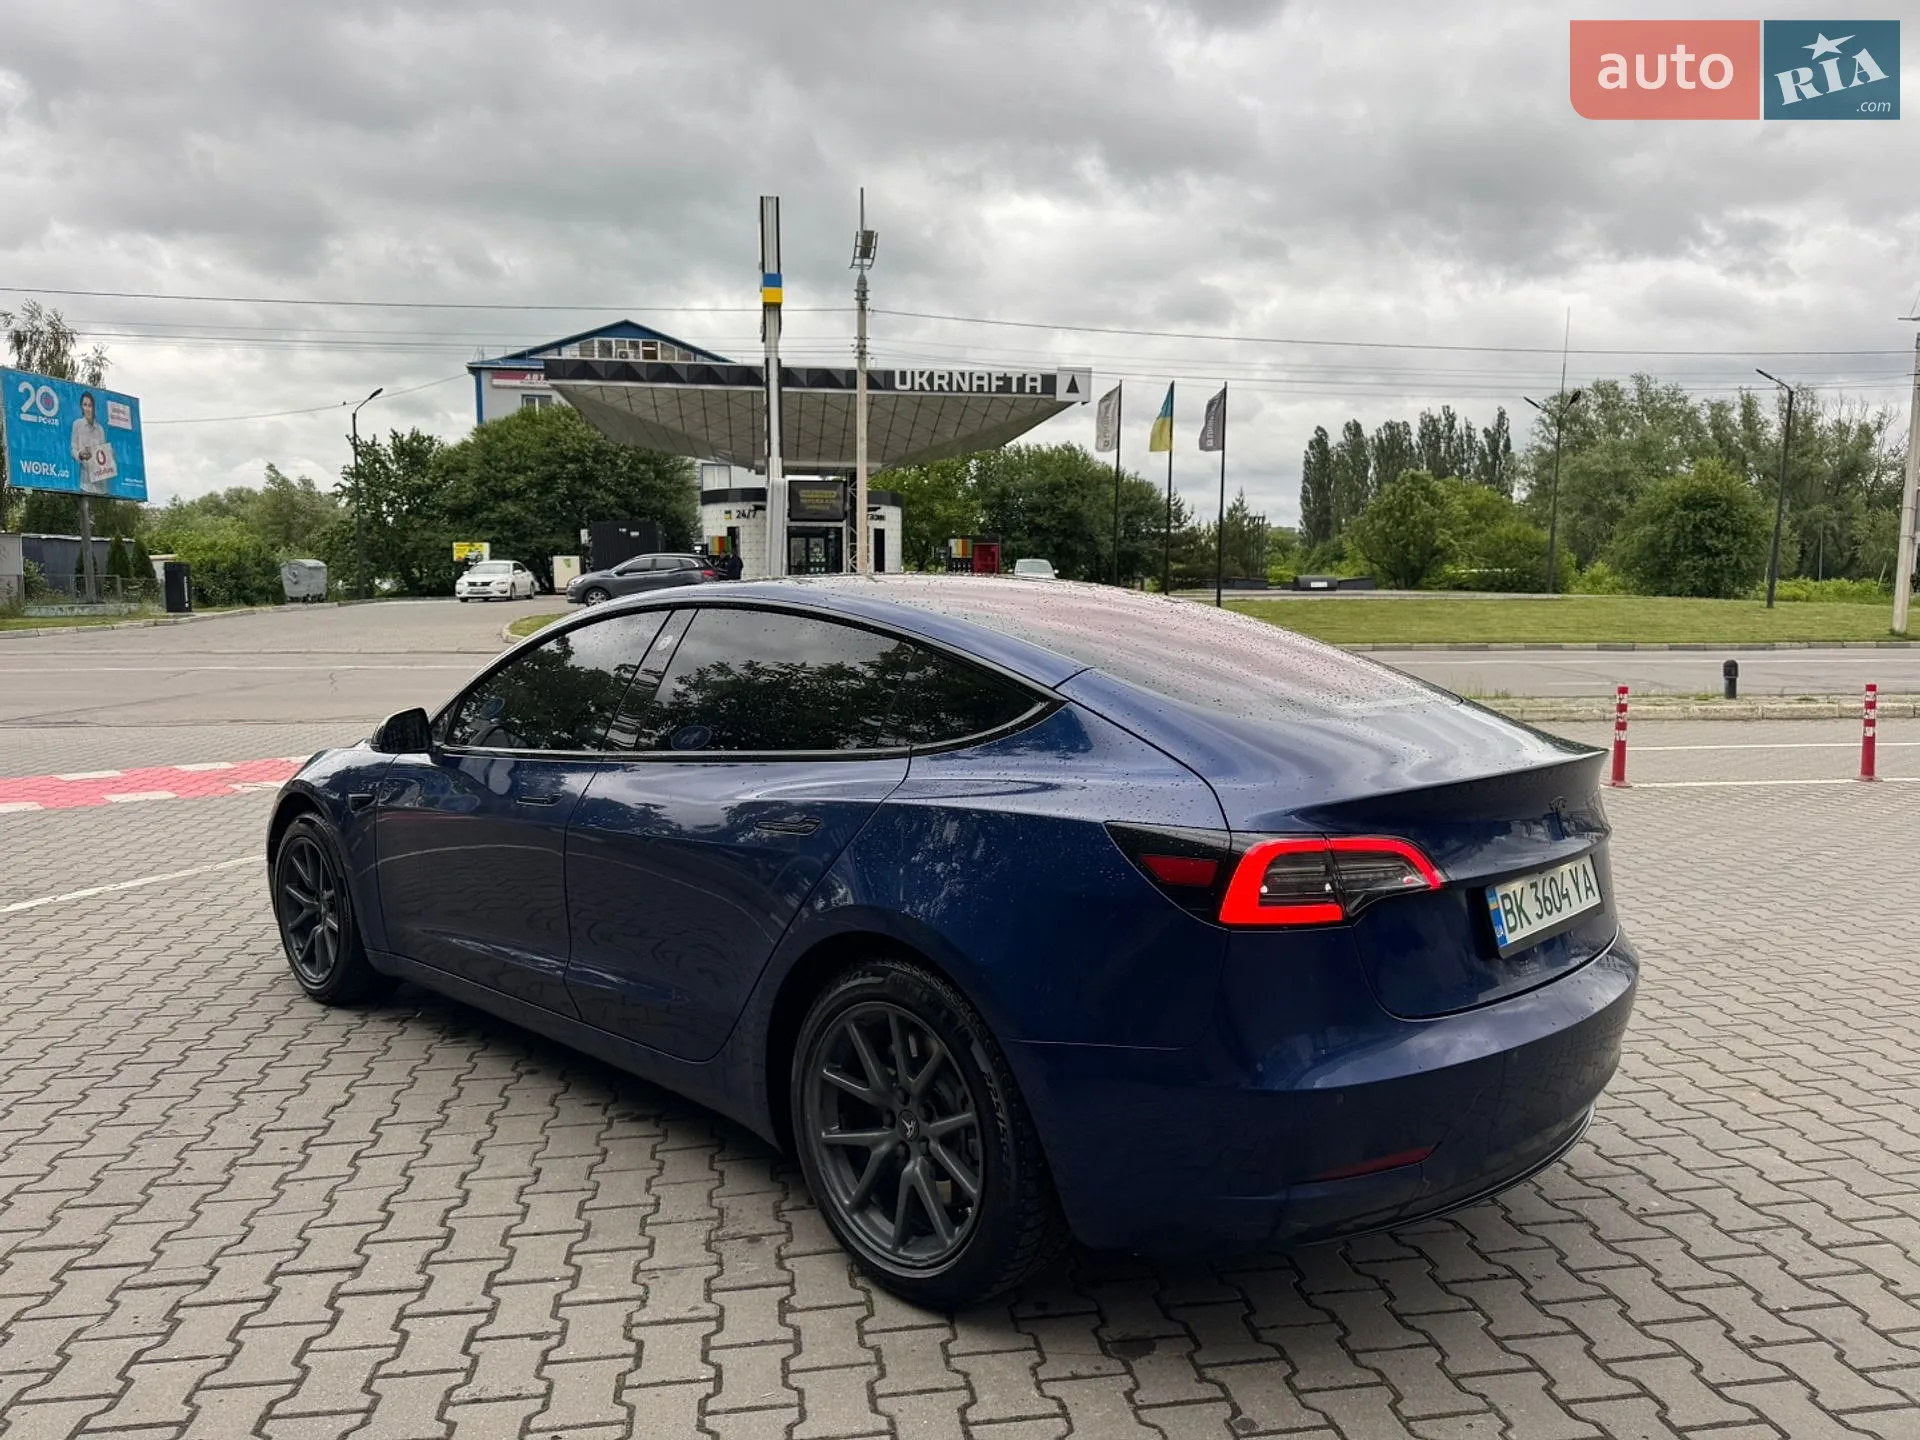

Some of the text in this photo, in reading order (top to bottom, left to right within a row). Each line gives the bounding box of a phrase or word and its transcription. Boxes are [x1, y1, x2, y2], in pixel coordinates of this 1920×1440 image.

[18, 381, 60, 422] 20
[894, 369, 1042, 393] UKRNAFTA
[1500, 863, 1596, 934] BK 3604 YA
